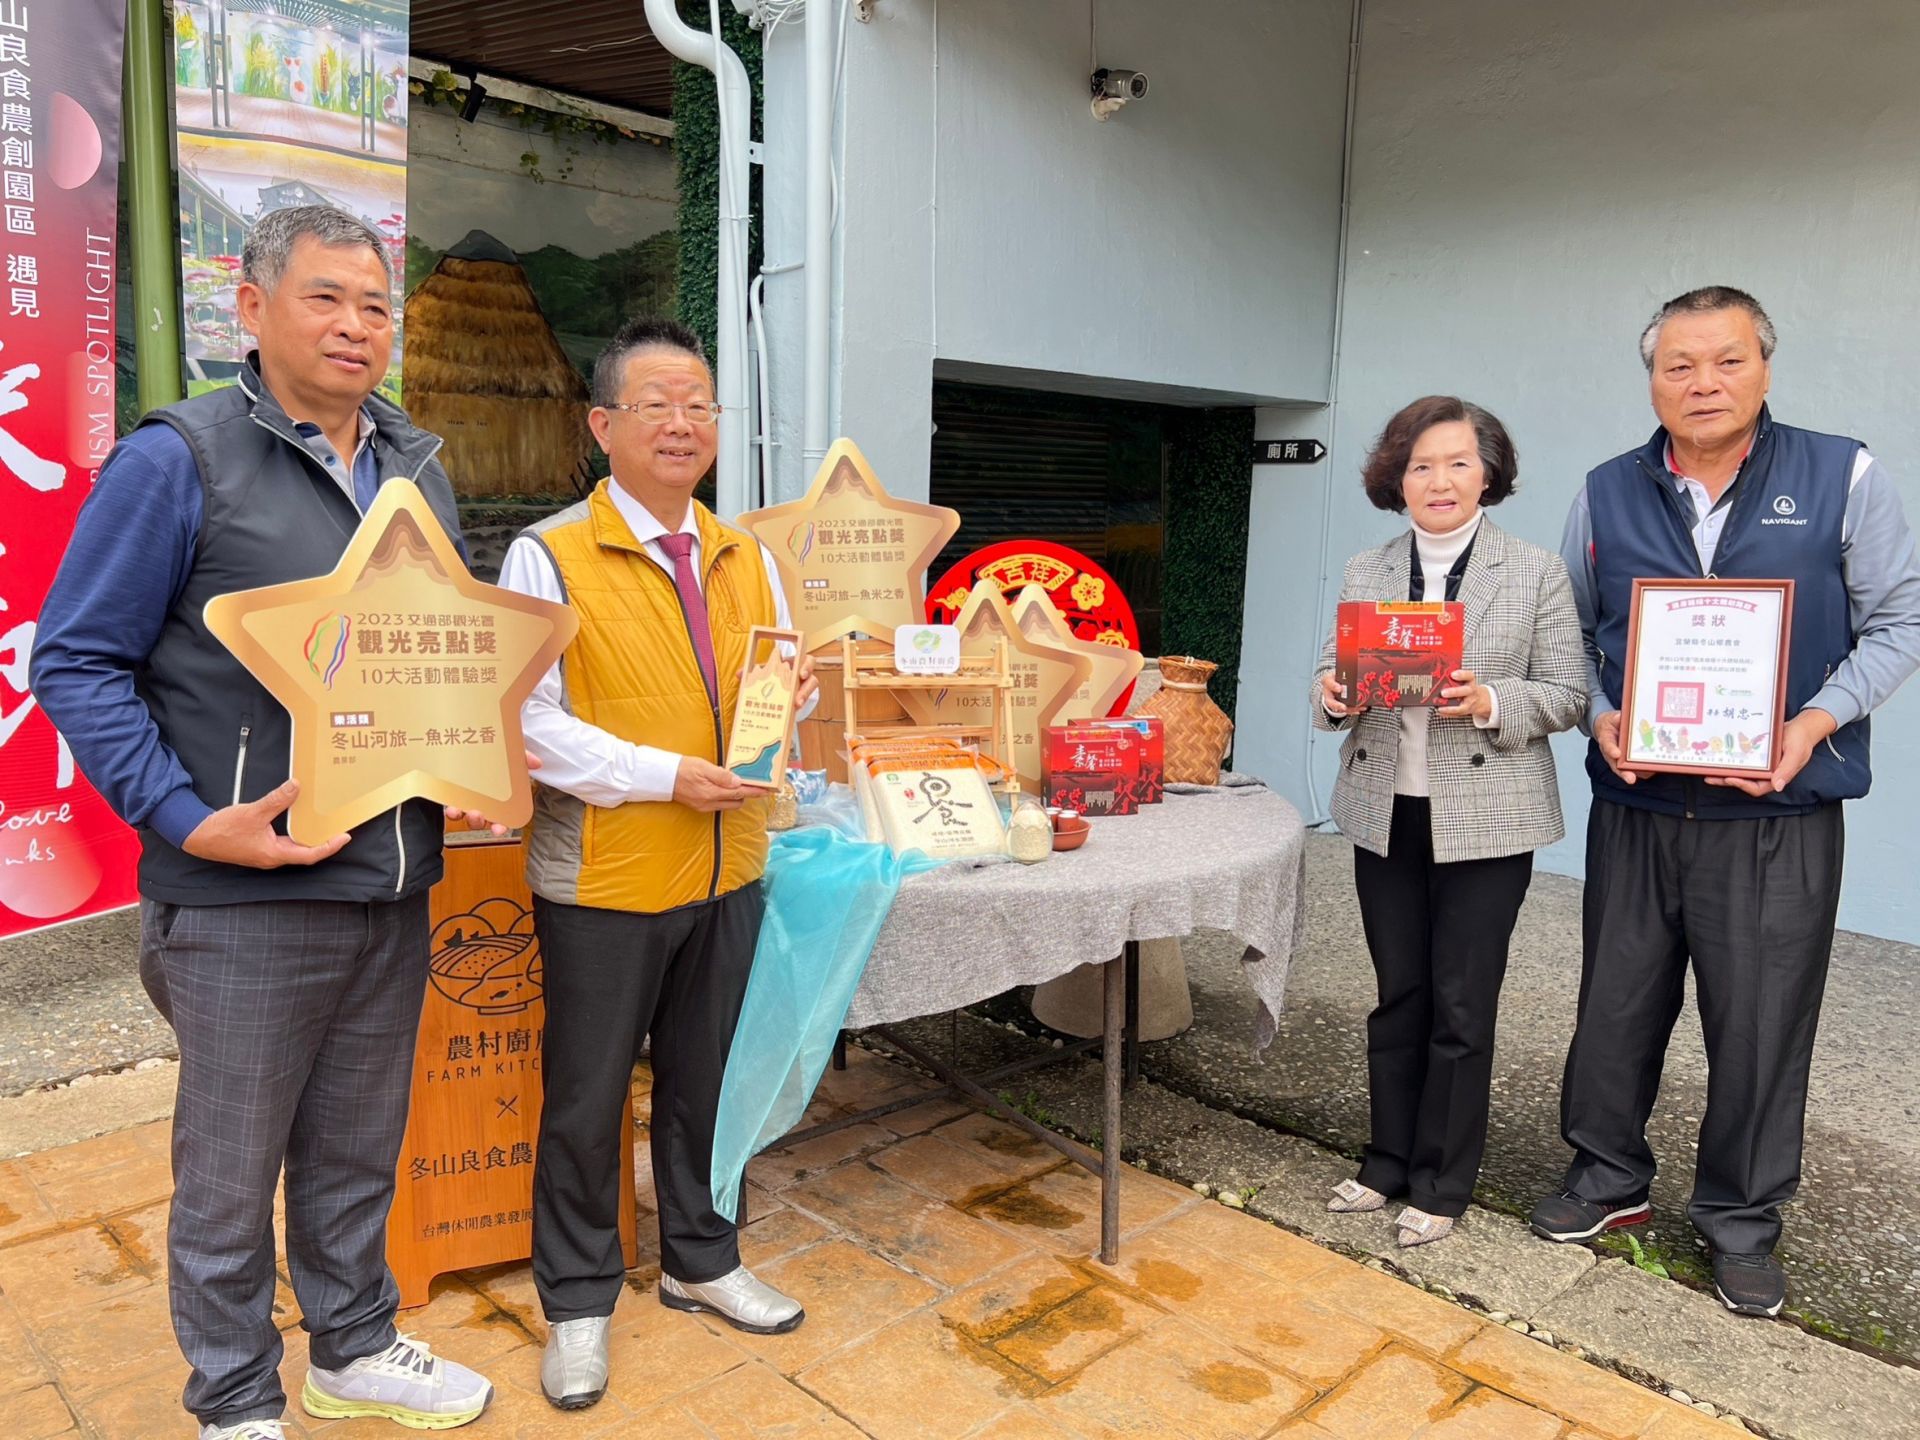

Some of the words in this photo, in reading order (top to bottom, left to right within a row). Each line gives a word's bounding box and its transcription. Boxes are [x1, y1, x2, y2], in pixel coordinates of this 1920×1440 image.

[7, 253, 40, 318] 遇見
[86, 227, 112, 397] SPOTLIGHT
[1267, 443, 1299, 459] 廁所
[818, 528, 905, 545] 觀光亮點獎
[821, 550, 905, 563] 10大活動體驗獎
[1003, 562, 1051, 584] 吉祥
[1691, 614, 1726, 628] 獎狀
[356, 629, 497, 654] 觀光亮點獎
[1381, 616, 1414, 650] 素馨
[361, 667, 498, 685] 10大活動體驗獎
[1070, 744, 1098, 770] 素馨
[427, 1065, 481, 1083] FARM
